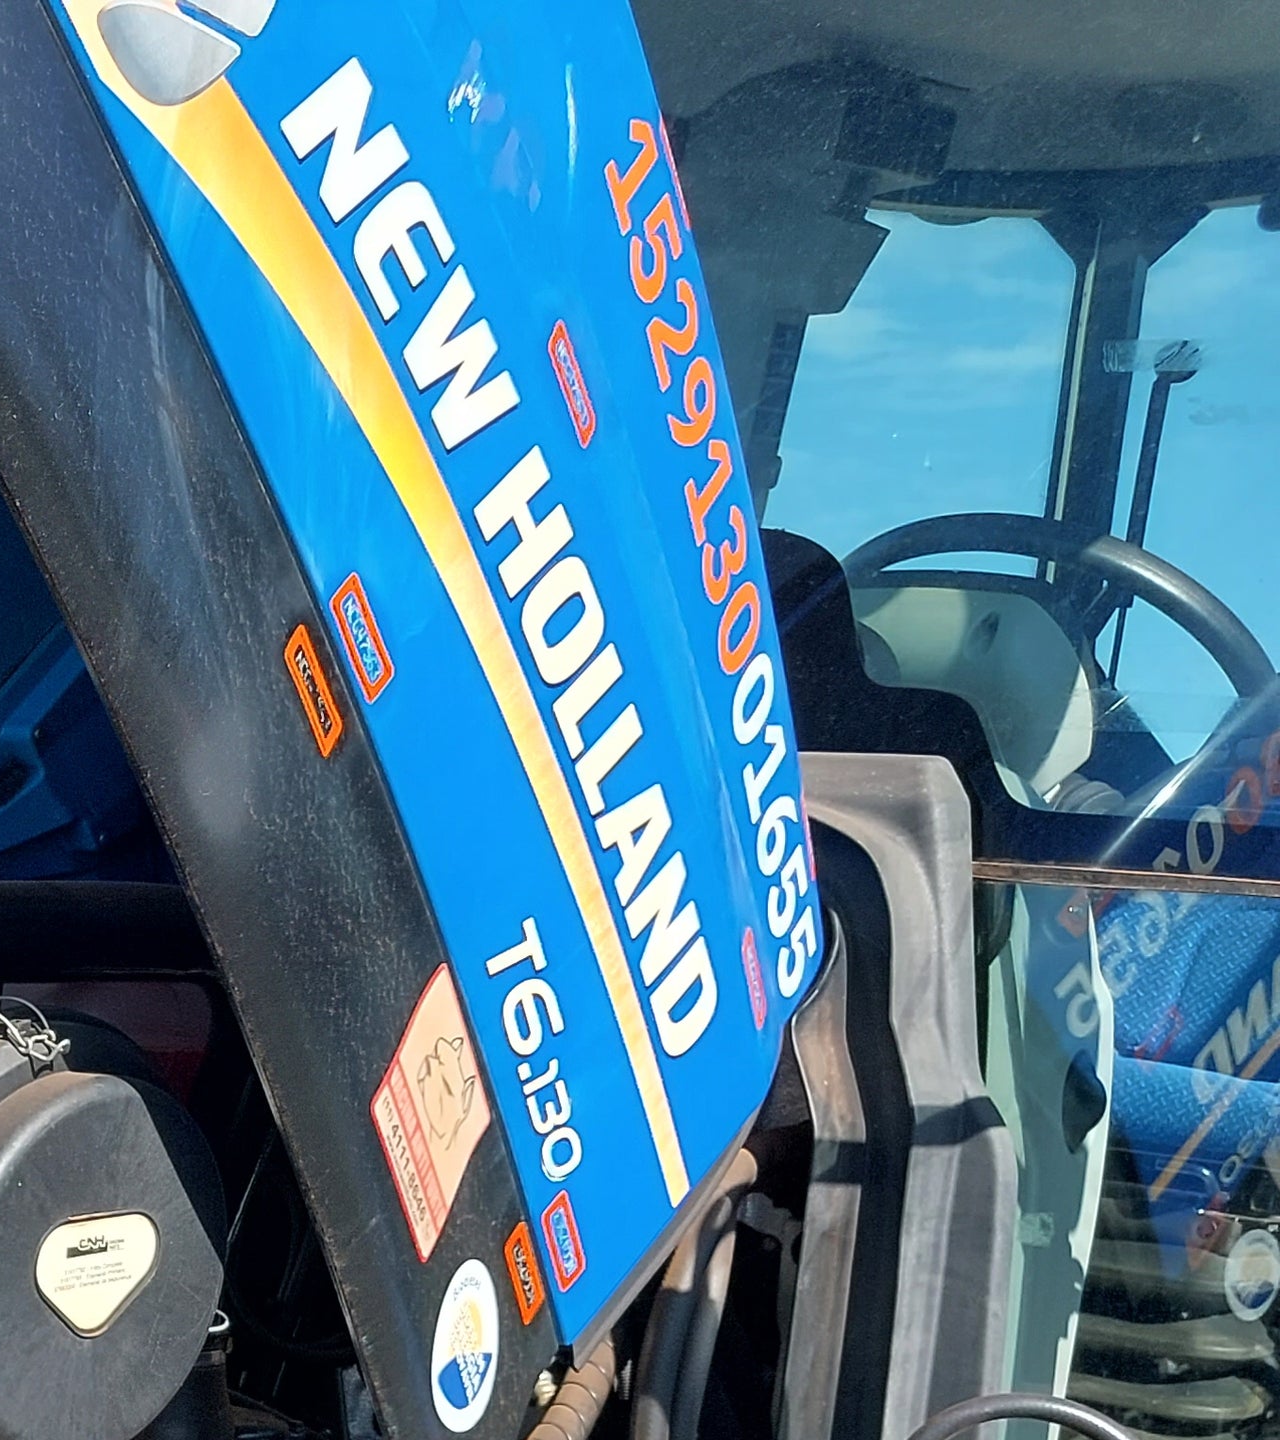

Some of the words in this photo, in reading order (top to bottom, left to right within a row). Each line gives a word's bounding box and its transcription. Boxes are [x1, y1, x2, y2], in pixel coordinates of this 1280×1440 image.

[279, 56, 522, 452] NEW
[473, 445, 719, 1059] HOLLAND
[604, 119, 817, 1000] 152913001655
[487, 917, 582, 1182] T6.130
